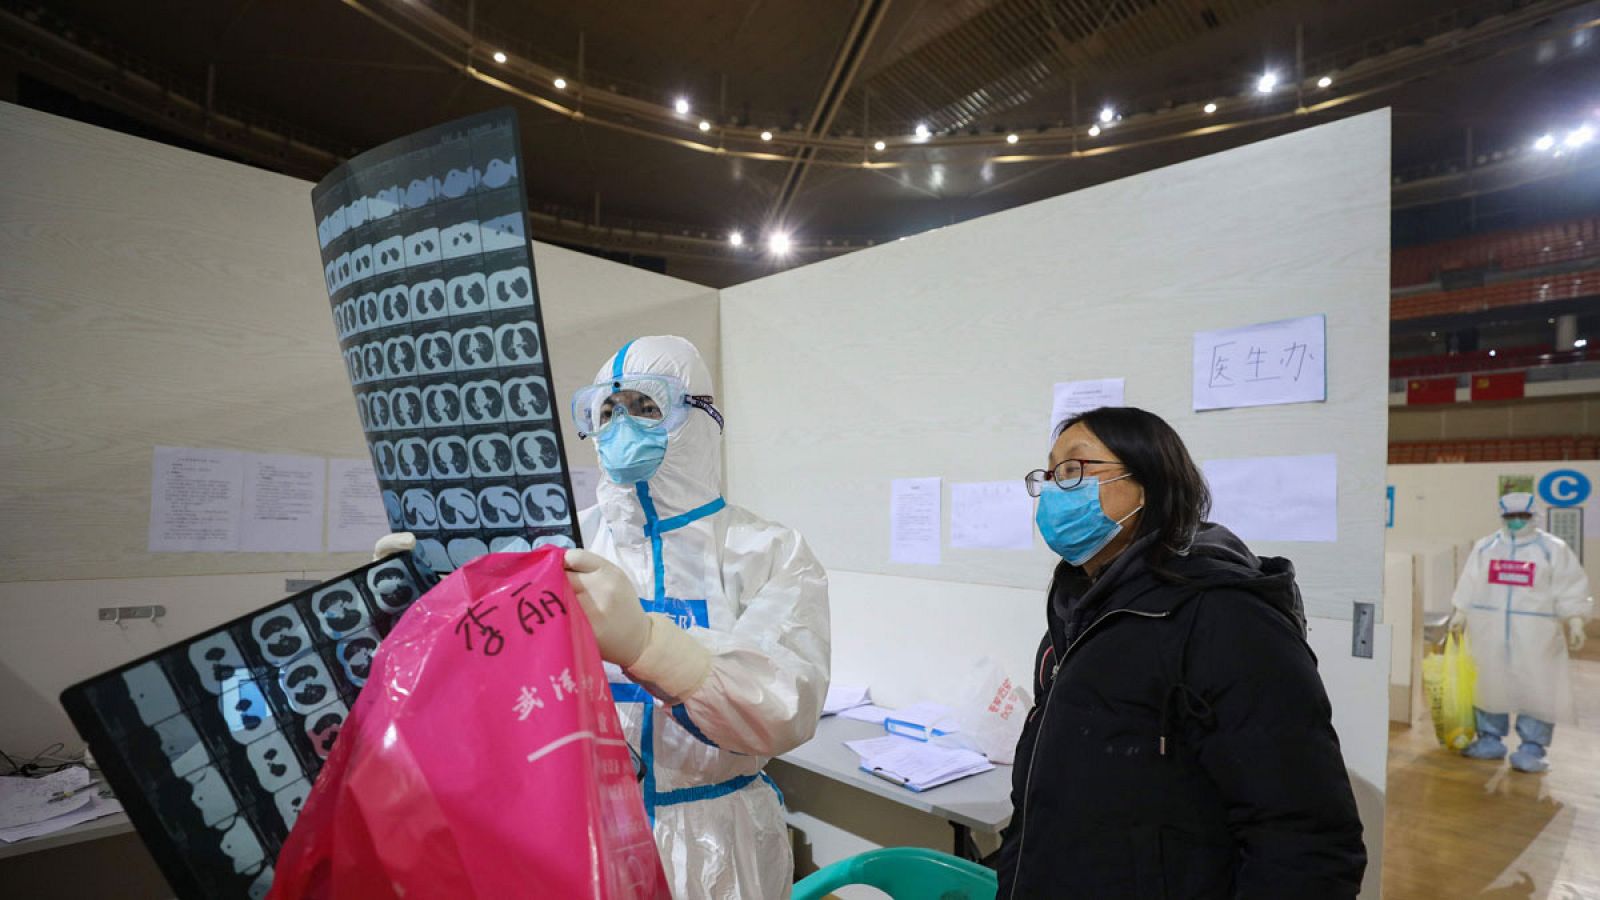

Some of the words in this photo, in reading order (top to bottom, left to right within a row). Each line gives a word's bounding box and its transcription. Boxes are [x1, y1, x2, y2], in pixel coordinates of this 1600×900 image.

[1208, 341, 1315, 388] 医生办
[1550, 476, 1579, 501] C
